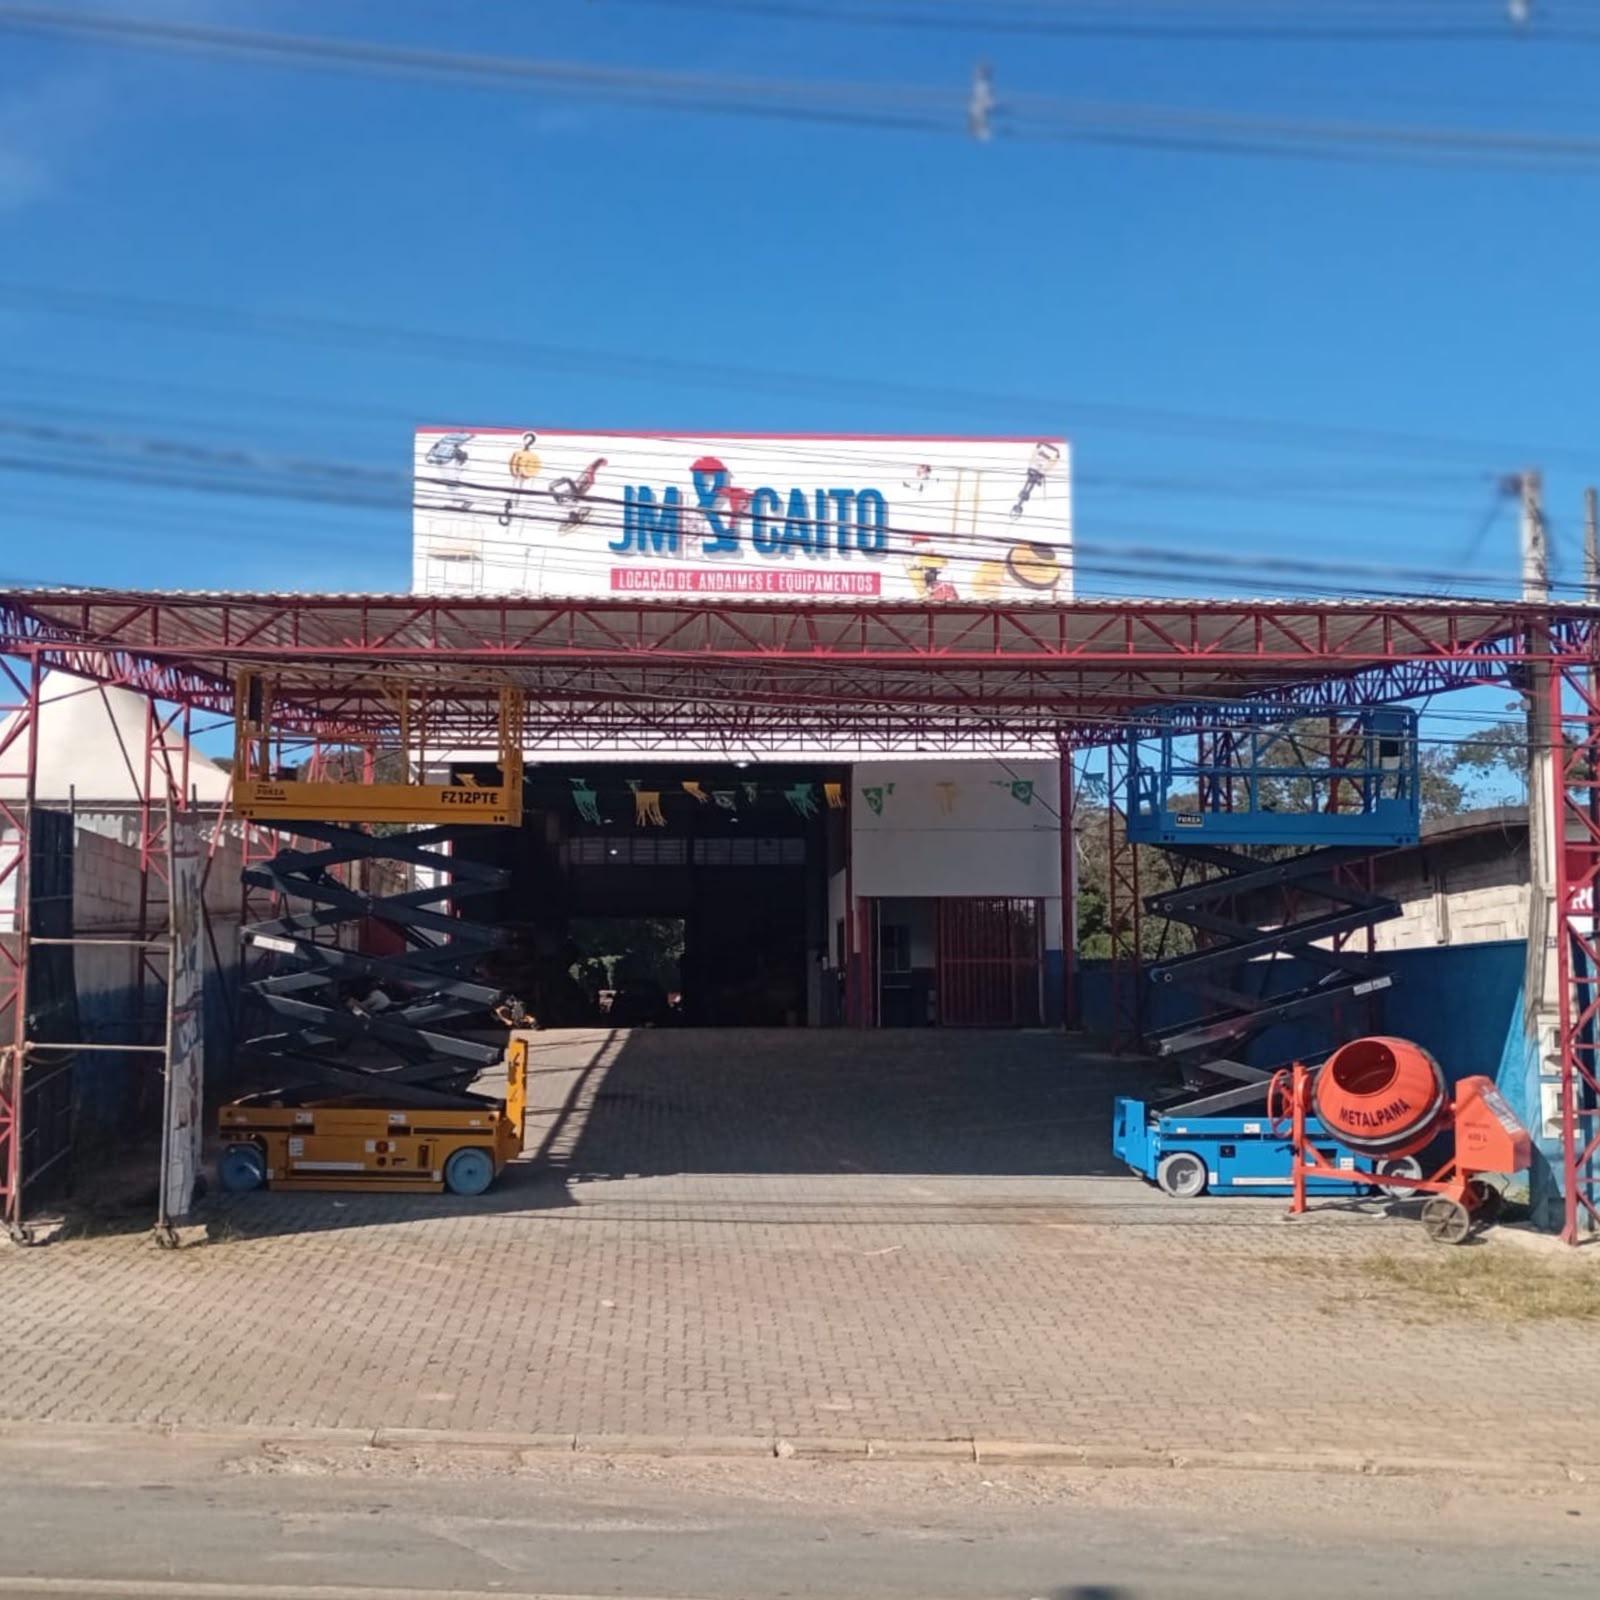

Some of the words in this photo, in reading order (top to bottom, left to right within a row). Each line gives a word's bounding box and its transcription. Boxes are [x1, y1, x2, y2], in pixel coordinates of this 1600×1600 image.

[608, 484, 682, 556] JM
[751, 486, 888, 561] CAITO
[619, 570, 675, 591] LOCAÇÃO
[677, 572, 692, 590] DE
[698, 572, 763, 591] ANDAIMES
[765, 573, 773, 591] E
[779, 573, 873, 593] EQUIPAMENTOS
[441, 790, 499, 805] FZ12PTE
[1340, 1097, 1412, 1128] METALPAMA
